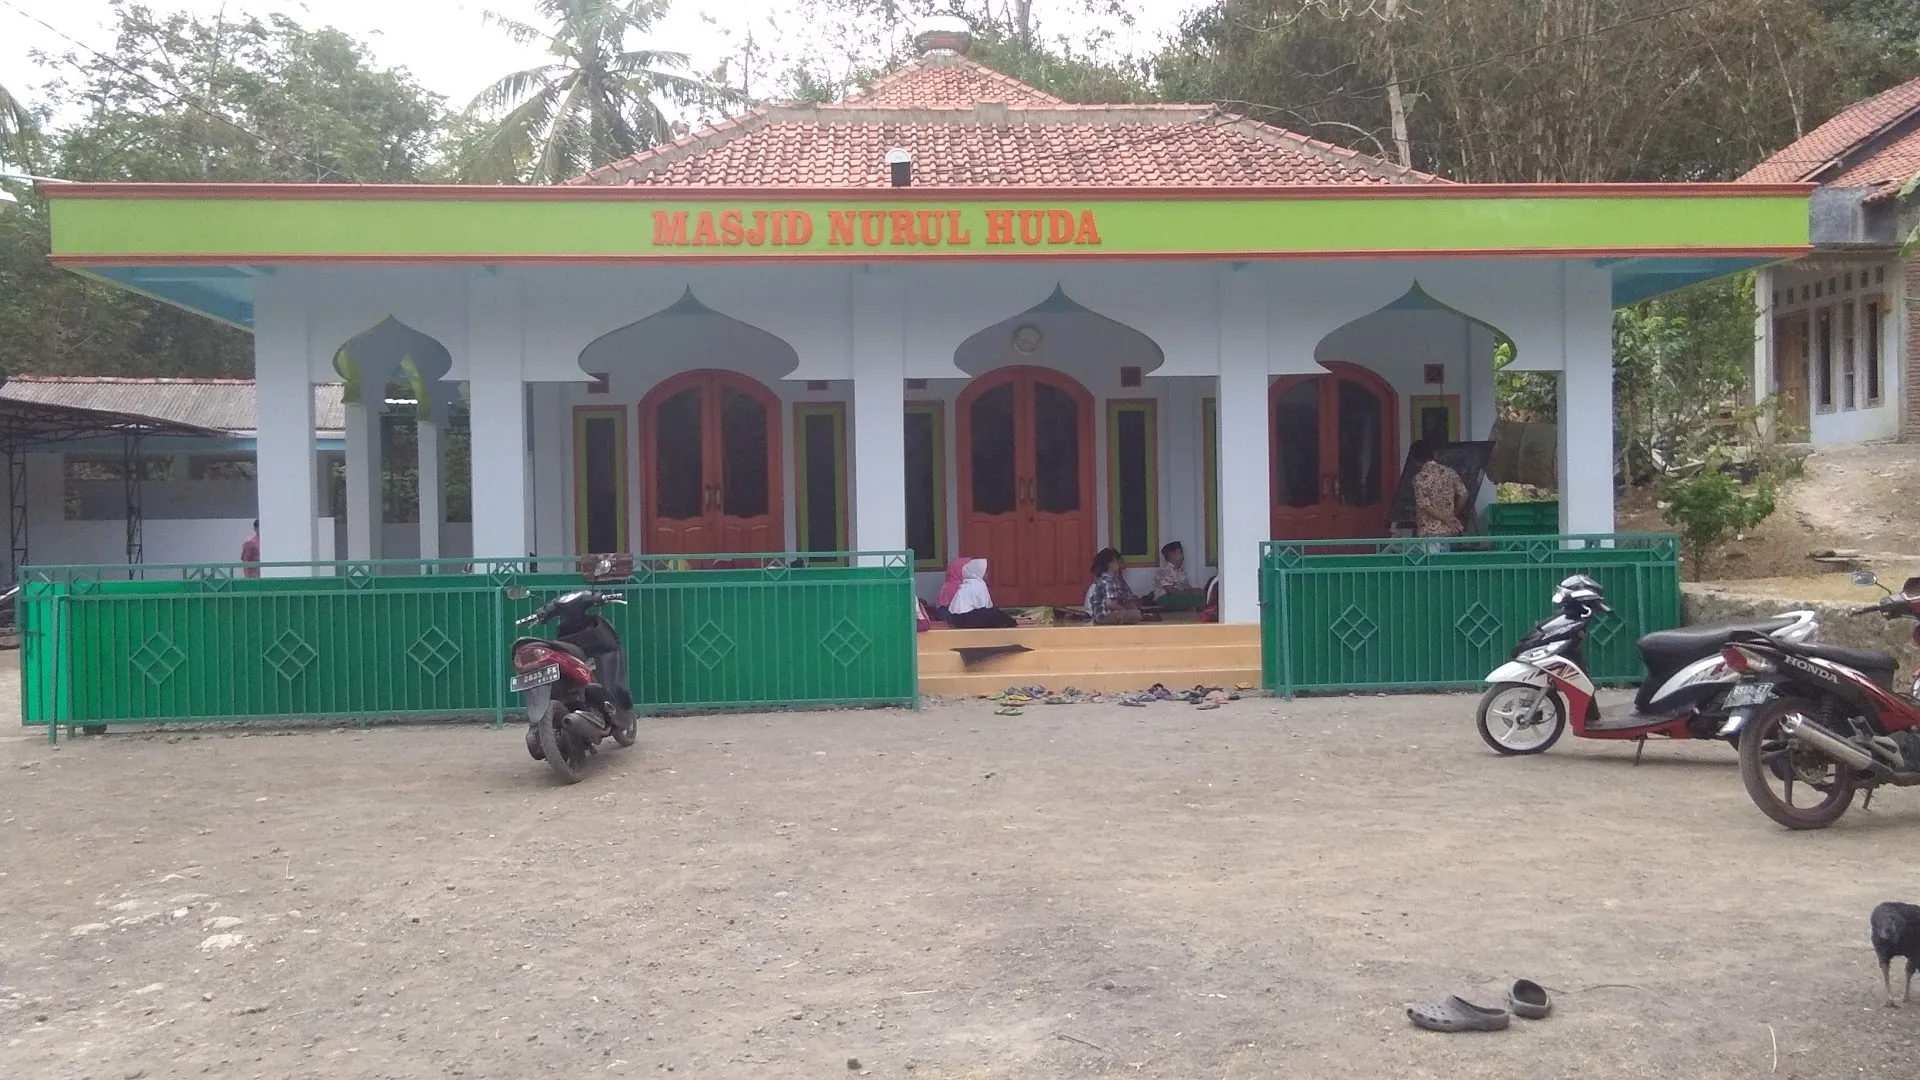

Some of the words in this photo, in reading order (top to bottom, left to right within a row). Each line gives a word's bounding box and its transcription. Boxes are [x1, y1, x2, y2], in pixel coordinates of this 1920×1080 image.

[651, 209, 814, 246] MASJID
[828, 209, 971, 246] NURUL
[984, 208, 1102, 244] HUDA
[1784, 655, 1841, 684] HONDA
